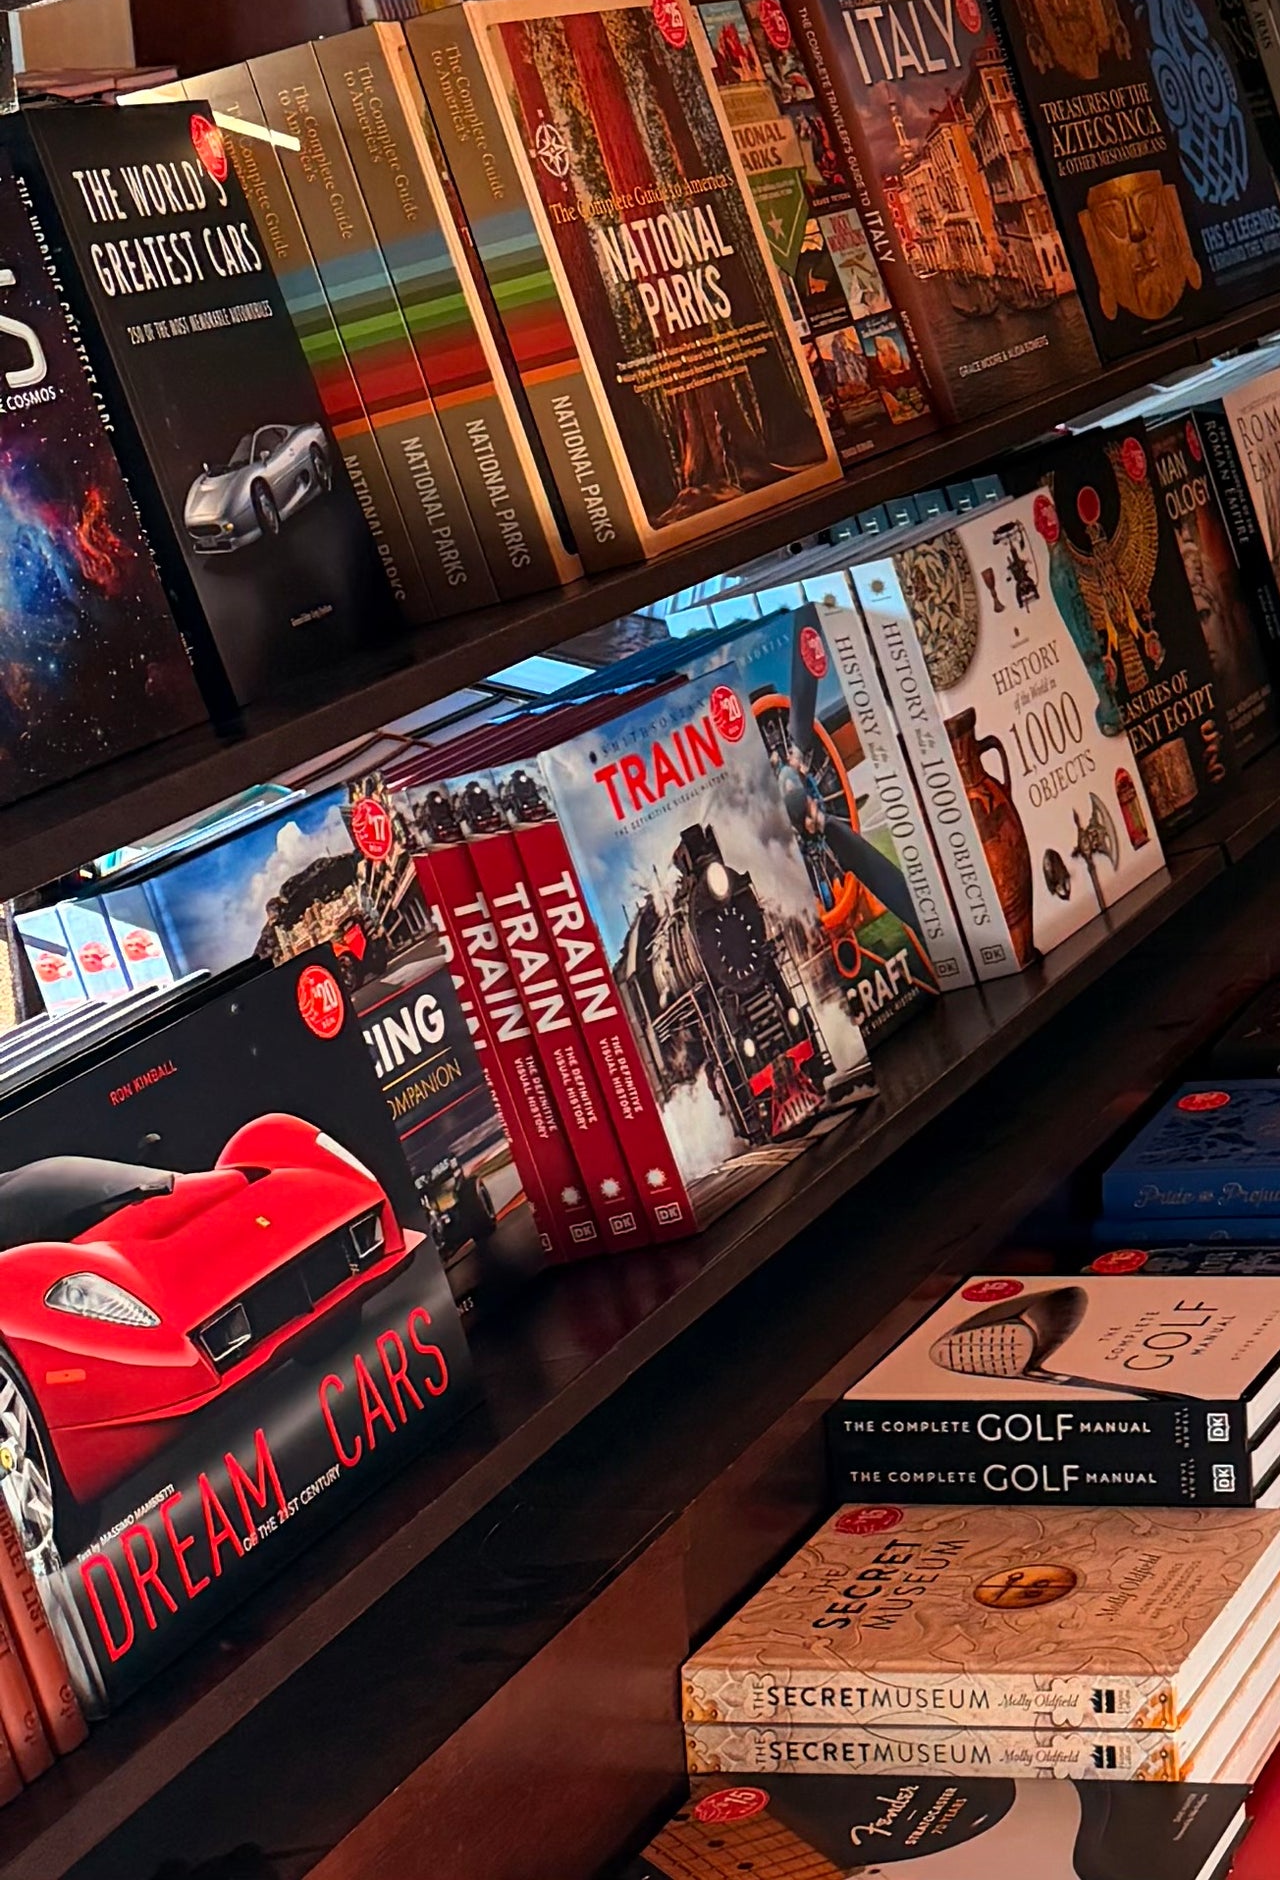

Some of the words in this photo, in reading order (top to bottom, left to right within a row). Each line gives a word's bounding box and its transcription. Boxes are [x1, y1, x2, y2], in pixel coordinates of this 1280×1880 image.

[1040, 95, 1110, 123] TREASURES
[1110, 86, 1130, 107] OF
[1131, 82, 1153, 104] THE
[1121, 106, 1163, 141] INCA
[72, 170, 125, 221] THE
[91, 230, 206, 297] GREATEST
[207, 222, 263, 278] CARS
[599, 204, 733, 286] NATIONAL
[639, 265, 732, 339] PARKS
[465, 419, 503, 506] NATIONAL
[495, 506, 531, 569] PARKS
[551, 395, 597, 486] NATIONAL
[583, 482, 616, 545] PARKS
[1205, 420, 1231, 478] ROMAN
[1224, 481, 1249, 544] EMPIRE
[883, 622, 928, 725] HISTORY
[993, 640, 1062, 696] HISTORY
[1009, 691, 1084, 777] 1,000
[1167, 683, 1217, 732] EGYPT
[594, 715, 726, 822] TRAIN
[1028, 749, 1096, 809] OBJECTS
[492, 881, 573, 1034] TRAIN
[537, 870, 618, 1024] TRAIN
[109, 1083, 133, 1106] RON
[1124, 1300, 1218, 1370] GOLF
[1191, 1314, 1237, 1356] MANUAL
[319, 1307, 449, 1469] CARS
[844, 1422, 877, 1433] THE
[882, 1421, 970, 1433] COMPLETE
[977, 1413, 1073, 1442] GOLF
[1079, 1421, 1151, 1433] MANUAL
[1208, 1414, 1229, 1441] DK
[1213, 1465, 1235, 1492] DK
[81, 1429, 286, 1662] DREAM
[812, 1539, 922, 1630] SECRET
[862, 1539, 970, 1630] MUSEUM
[850, 1784, 920, 1846] Fender
[905, 1787, 959, 1845] STRATOCASTER
